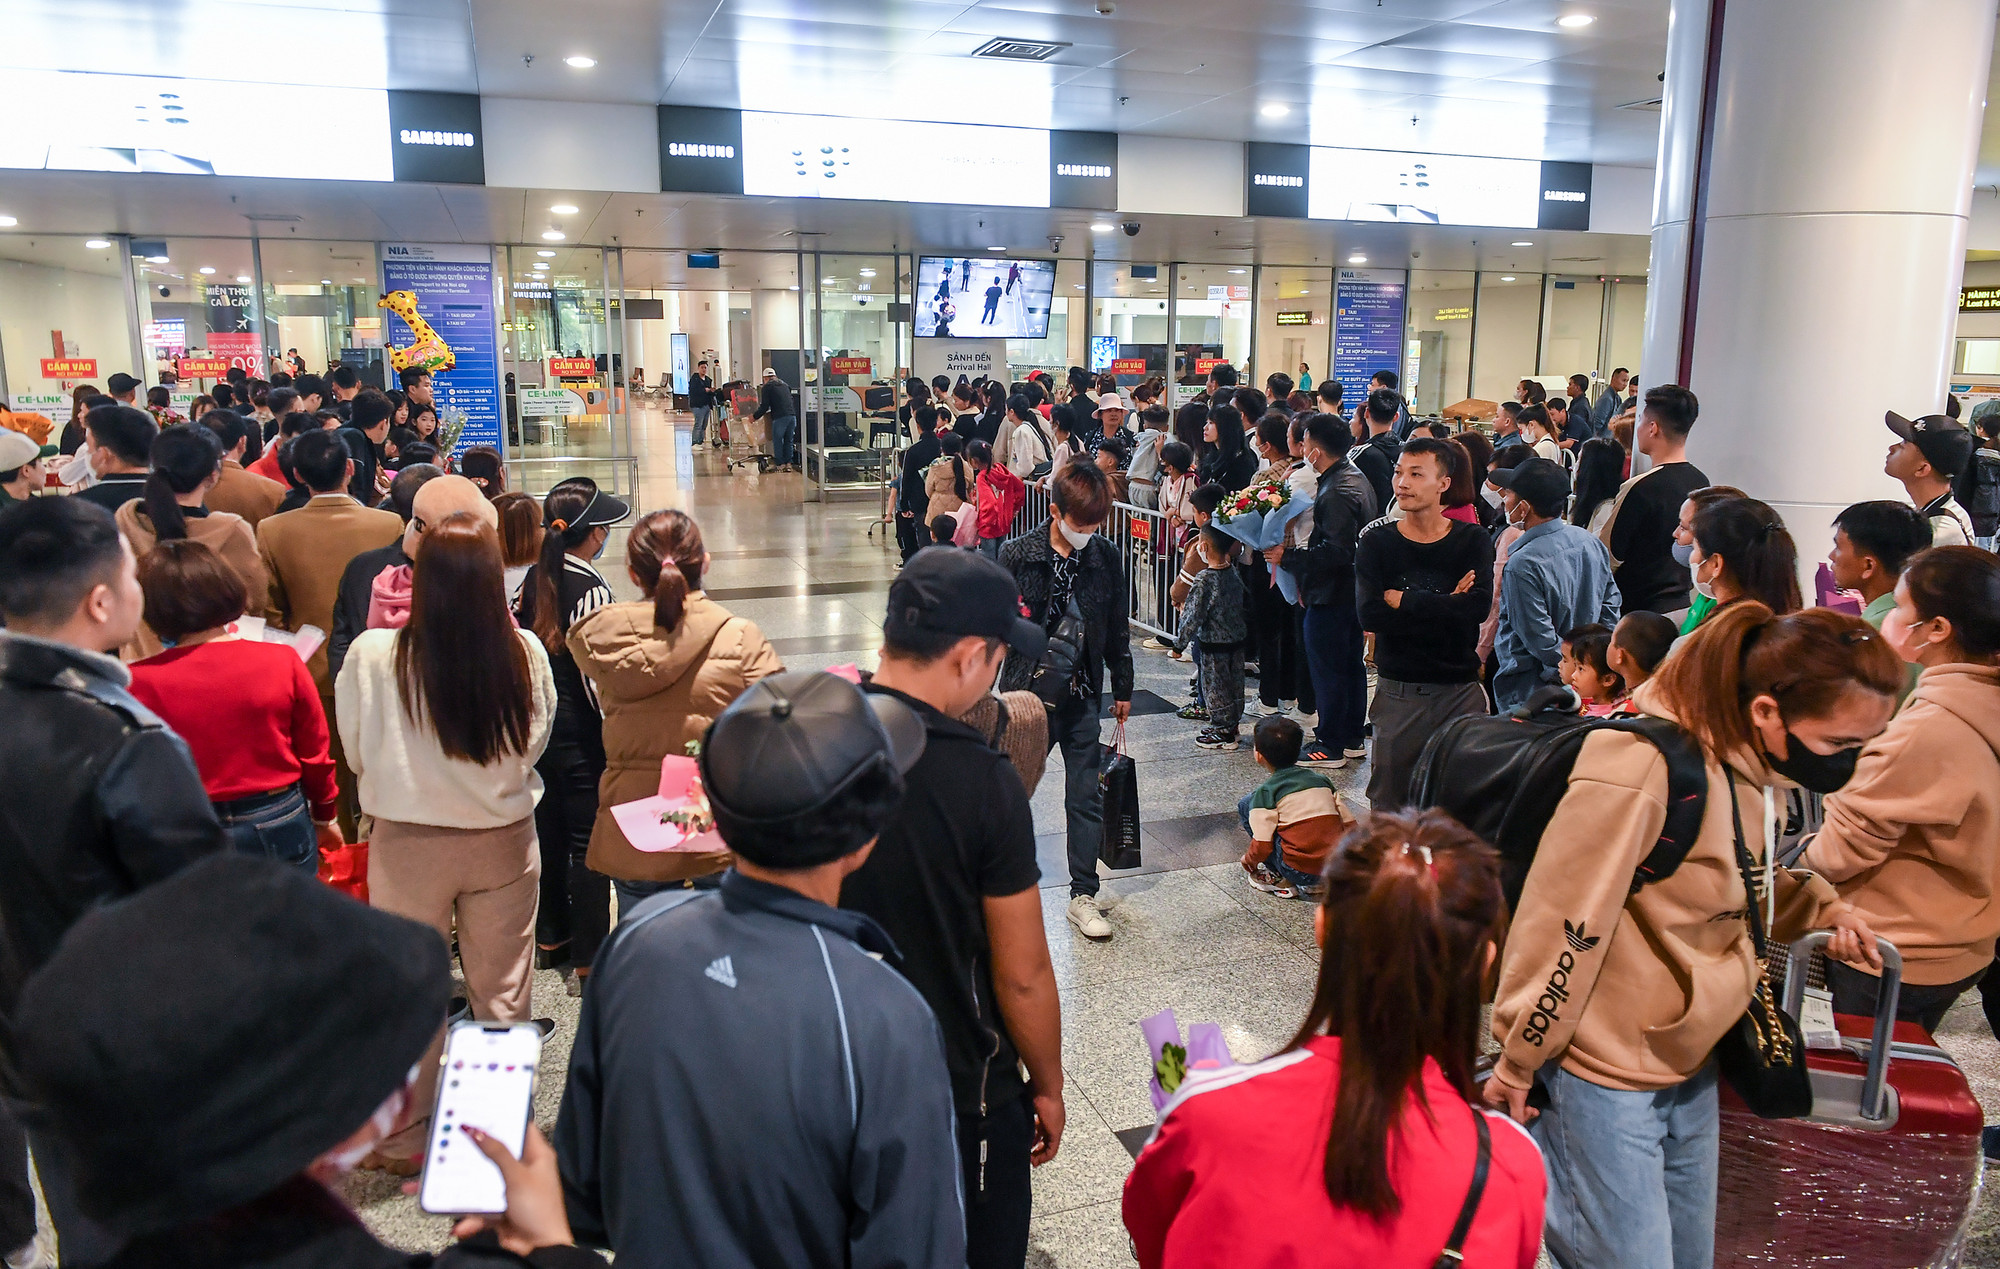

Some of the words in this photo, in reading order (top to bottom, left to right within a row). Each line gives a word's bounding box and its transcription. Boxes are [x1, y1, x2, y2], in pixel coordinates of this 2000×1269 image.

[401, 129, 474, 147] SAMSUNG
[669, 142, 735, 159] SAMSUNG
[1057, 163, 1112, 178] SAMSUNG
[1254, 174, 1304, 188] SAMSUNG
[1544, 190, 1586, 202] SAMSUNG
[388, 246, 409, 255] NIA
[206, 285, 227, 296] MIỄN
[228, 285, 254, 296] THUẾ
[1968, 290, 1990, 299] HÀNH
[1991, 290, 2000, 298] LÝ
[231, 296, 251, 307] CẤP
[1966, 300, 1984, 308] Lost
[947, 352, 973, 362] SẢNH
[975, 351, 992, 362] ĐẾN
[47, 361, 70, 371] CẤM
[72, 361, 92, 371] VÀO
[184, 360, 206, 371] CẤM
[208, 361, 226, 371] VÀO
[554, 361, 573, 370] CẤM
[575, 361, 591, 370] VÀO
[835, 361, 852, 369] CẤM
[853, 361, 867, 369] VÀO
[946, 363, 975, 371] Arrival
[1114, 361, 1129, 369] CẤM
[1130, 361, 1143, 369] VÀO
[1199, 361, 1213, 369] CẤM
[527, 390, 564, 398] CE-LINK
[18, 396, 62, 404] CE-LINK
[1522, 950, 1575, 1048] adidas
